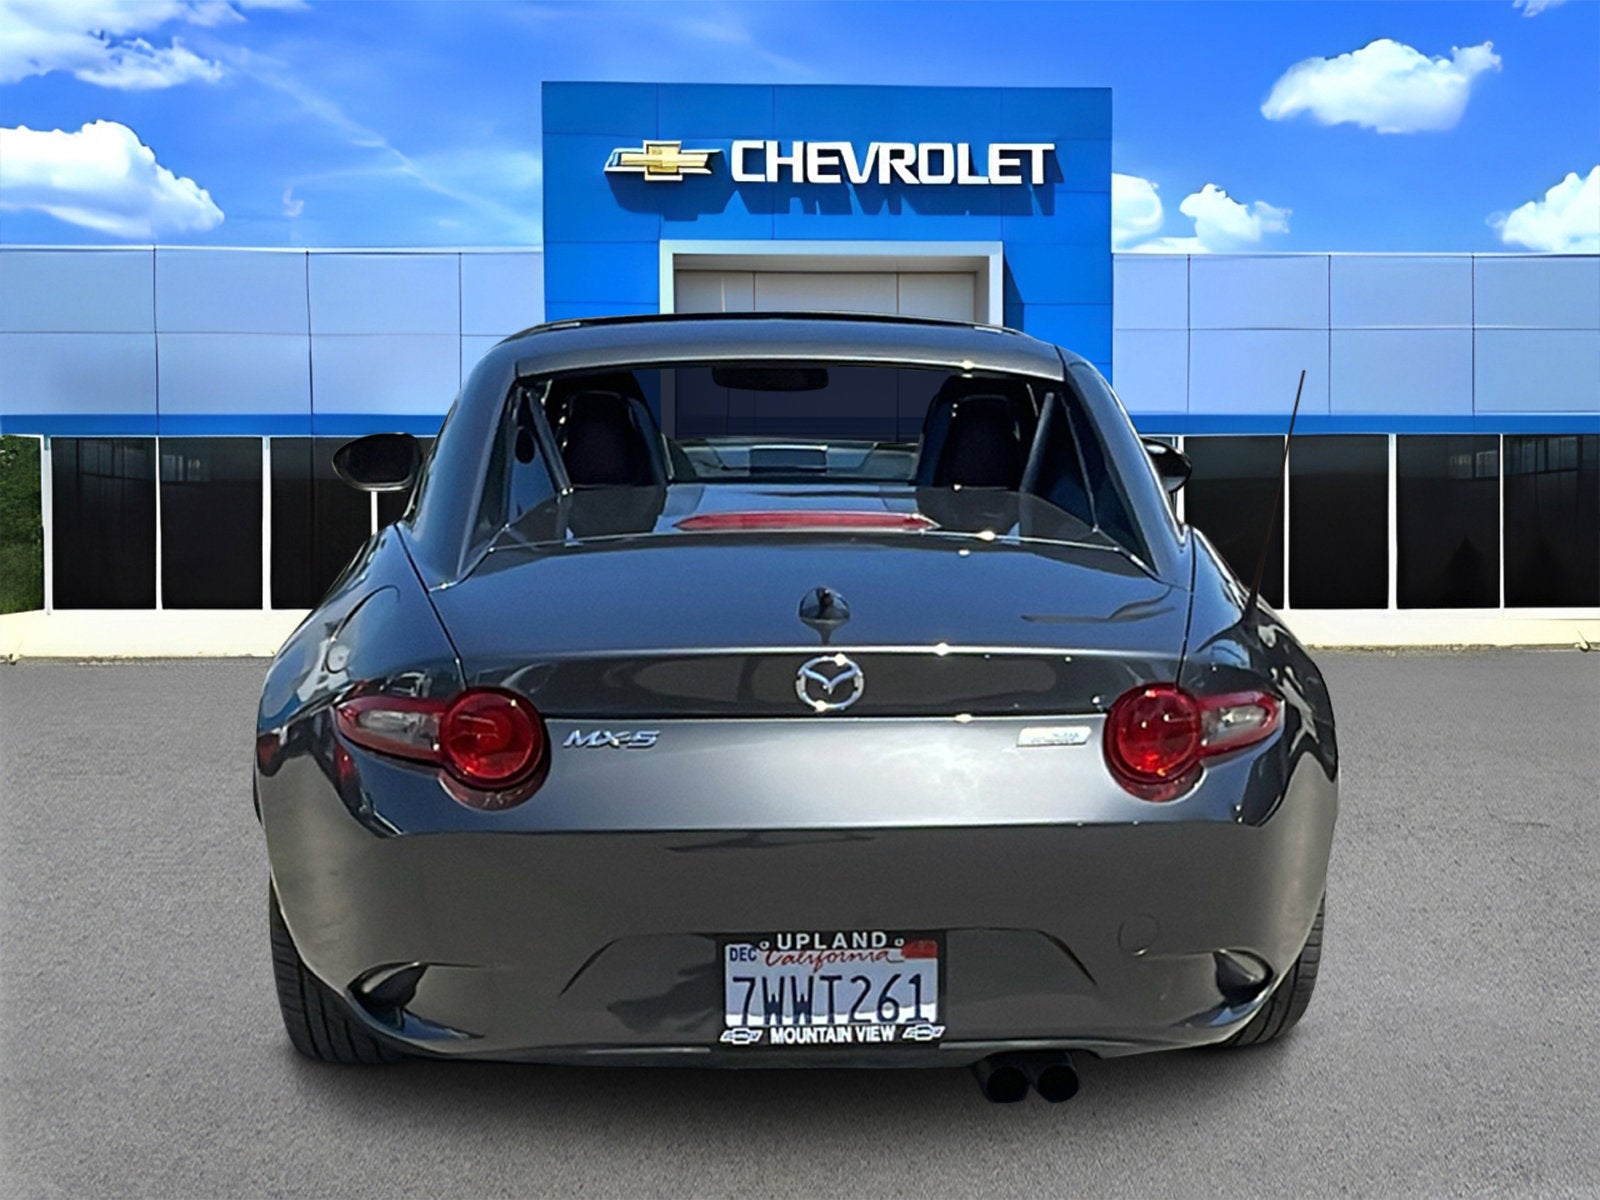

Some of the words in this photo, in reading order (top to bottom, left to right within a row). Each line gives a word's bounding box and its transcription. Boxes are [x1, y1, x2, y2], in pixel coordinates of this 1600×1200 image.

[731, 139, 1055, 184] CHEVROLET
[563, 729, 660, 747] MX-5
[777, 931, 887, 950] UPLAND
[729, 947, 757, 961] DEC
[765, 949, 904, 973] California
[732, 973, 929, 1025] 7WWT261
[770, 1026, 851, 1044] MOUNTAIN
[856, 1025, 896, 1042] VIEW
